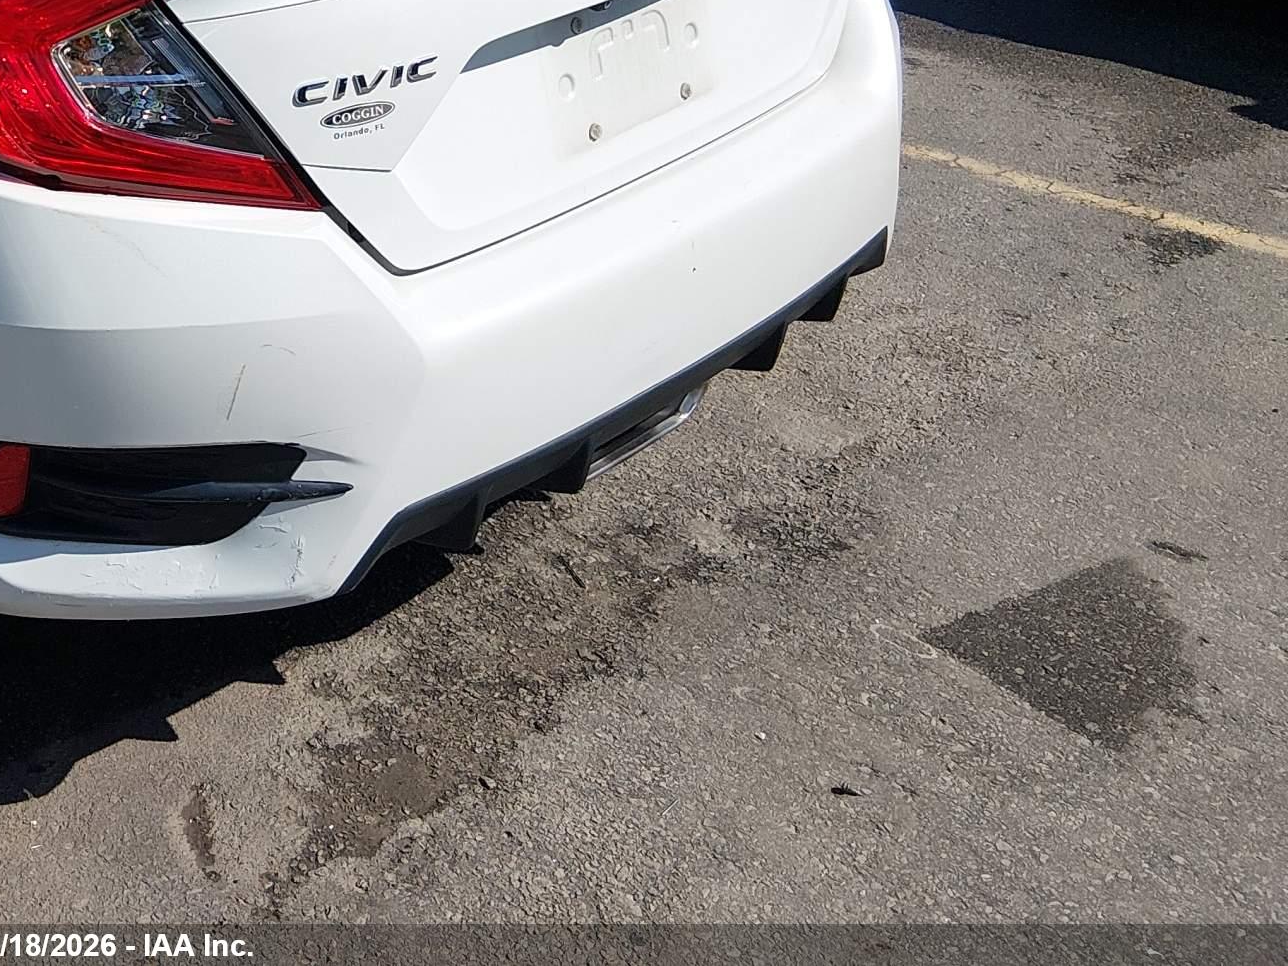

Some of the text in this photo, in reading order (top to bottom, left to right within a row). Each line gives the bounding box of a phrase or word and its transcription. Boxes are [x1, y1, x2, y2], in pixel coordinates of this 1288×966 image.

[292, 55, 439, 108] CIVIC
[331, 104, 385, 125] COGGIN
[333, 126, 373, 140] Orlando,
